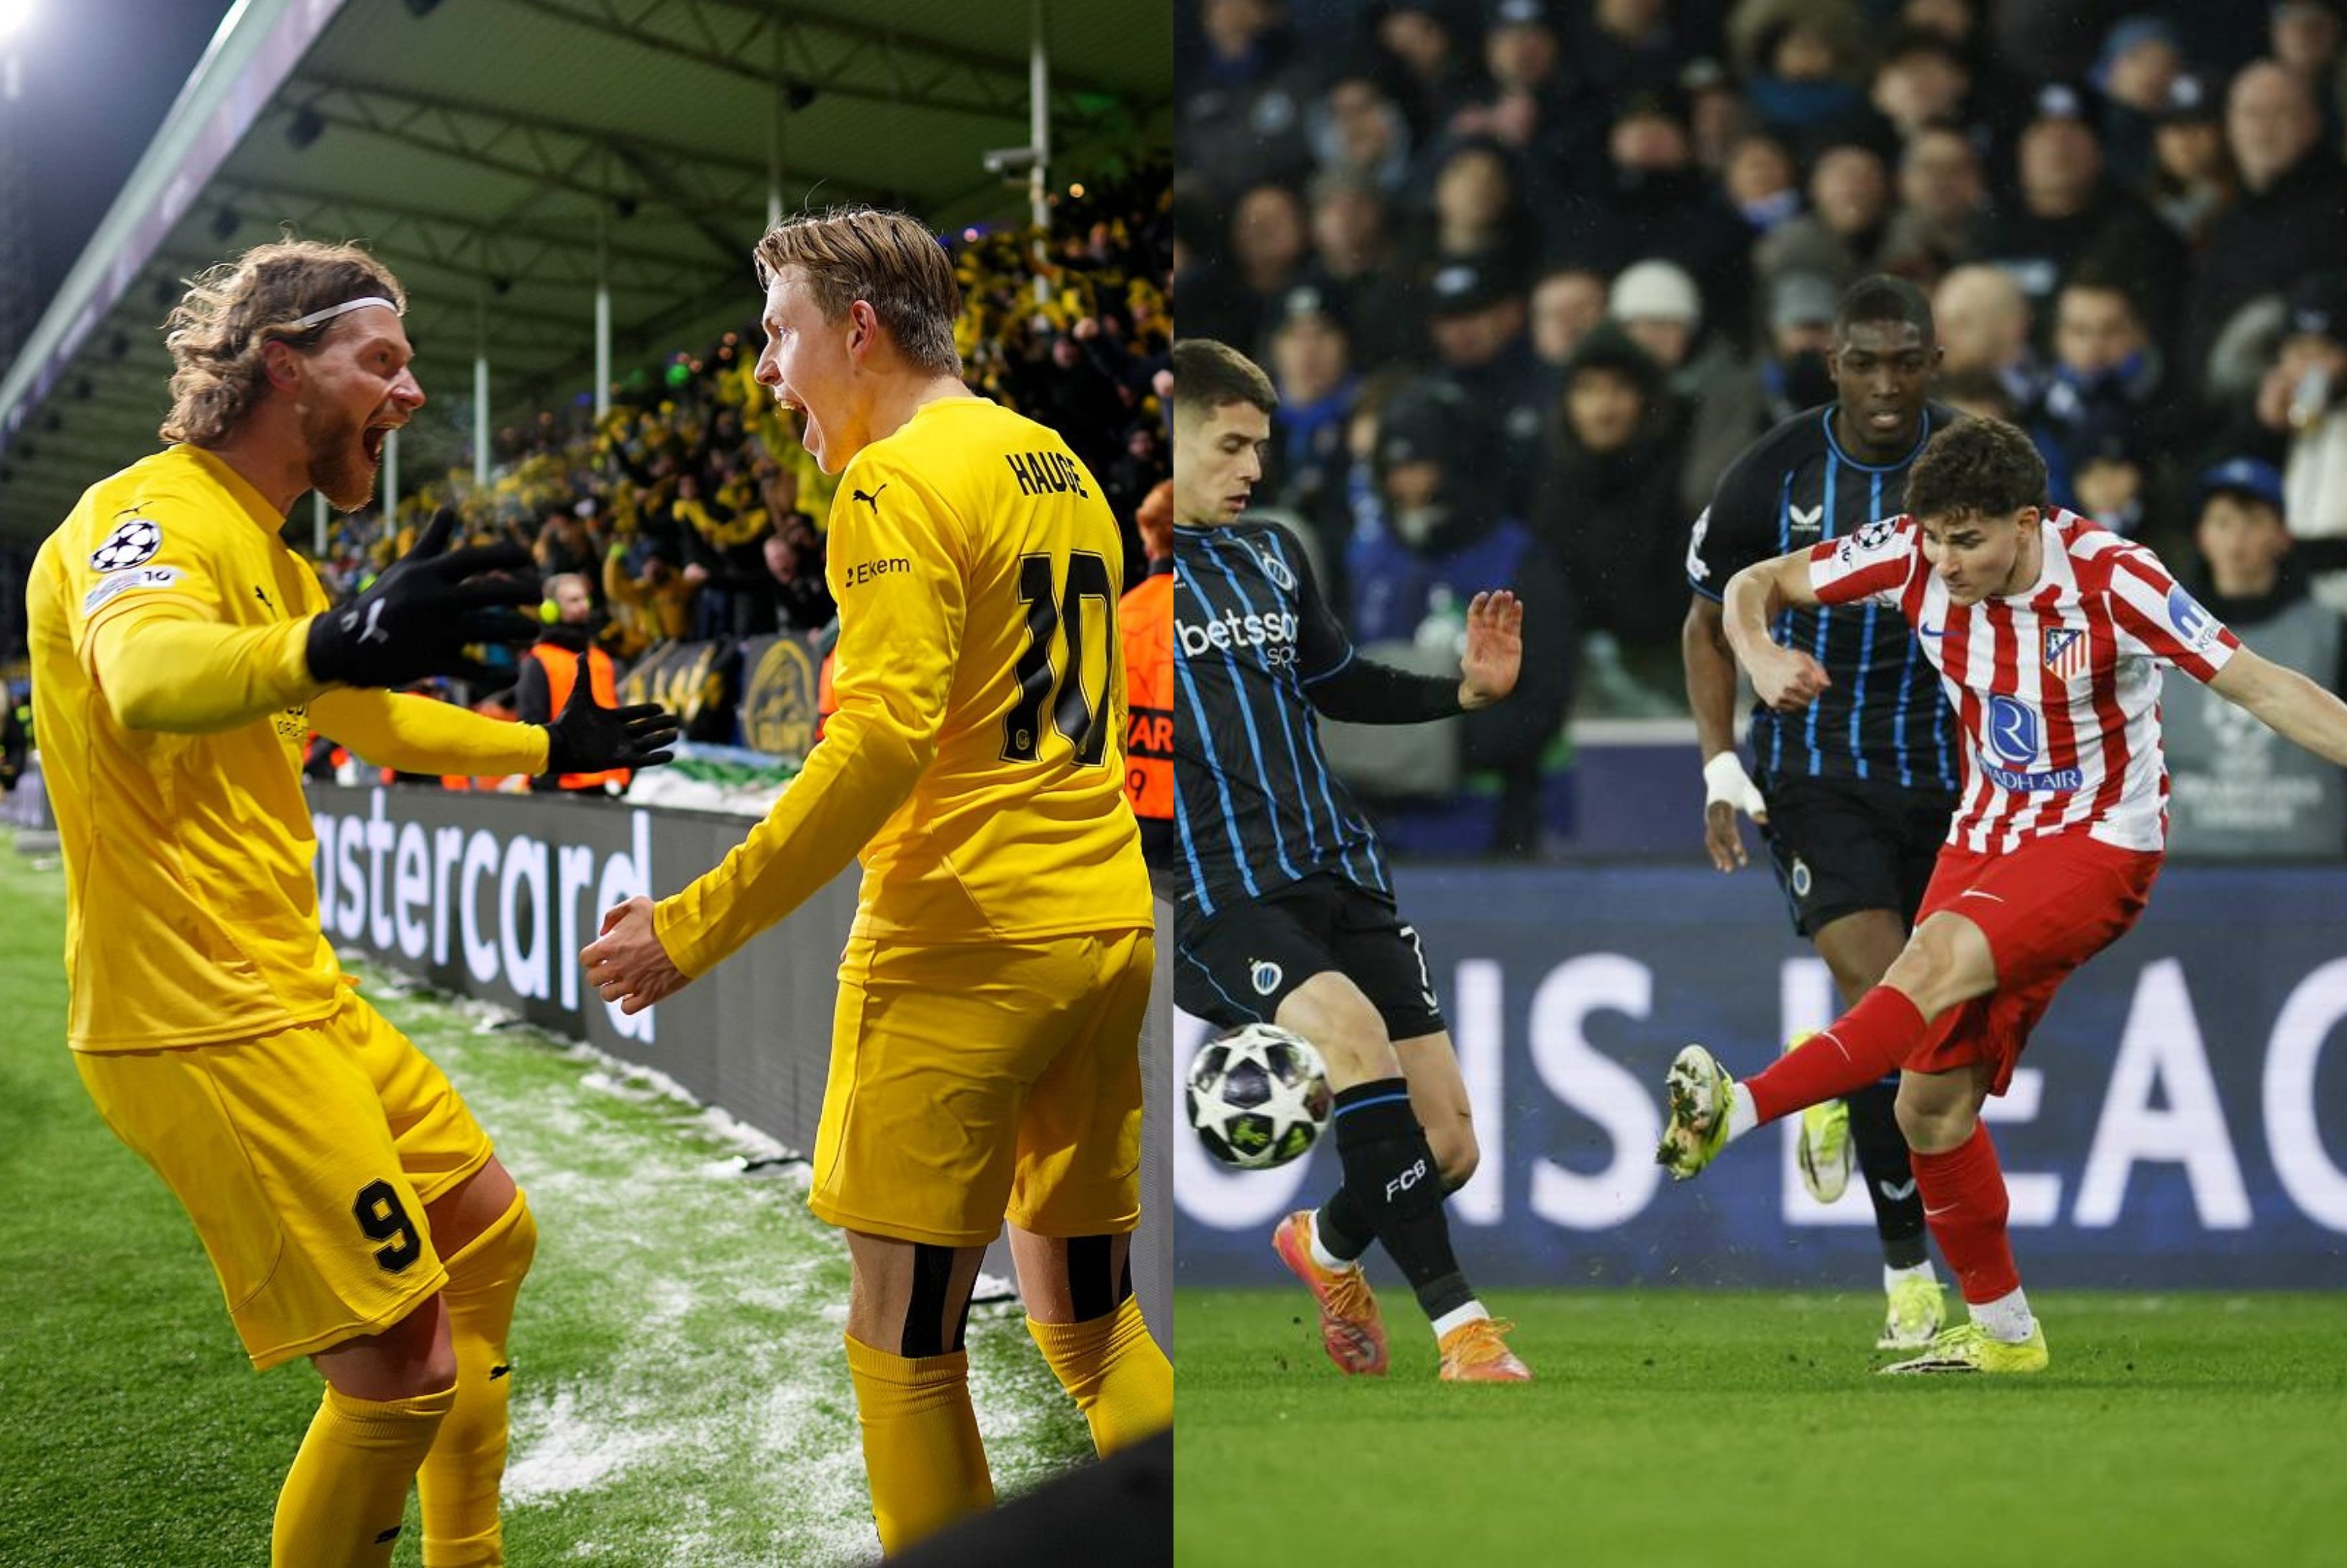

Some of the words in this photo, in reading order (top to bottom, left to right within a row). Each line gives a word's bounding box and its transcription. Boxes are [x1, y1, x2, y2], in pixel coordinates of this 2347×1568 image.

[1005, 451, 1089, 499] HAUGE
[1174, 608, 1299, 657] betsso
[999, 549, 1113, 768] 10
[2041, 770, 2078, 789] AIR
[1386, 1160, 1427, 1203] FCB
[352, 1178, 422, 1275] 9
